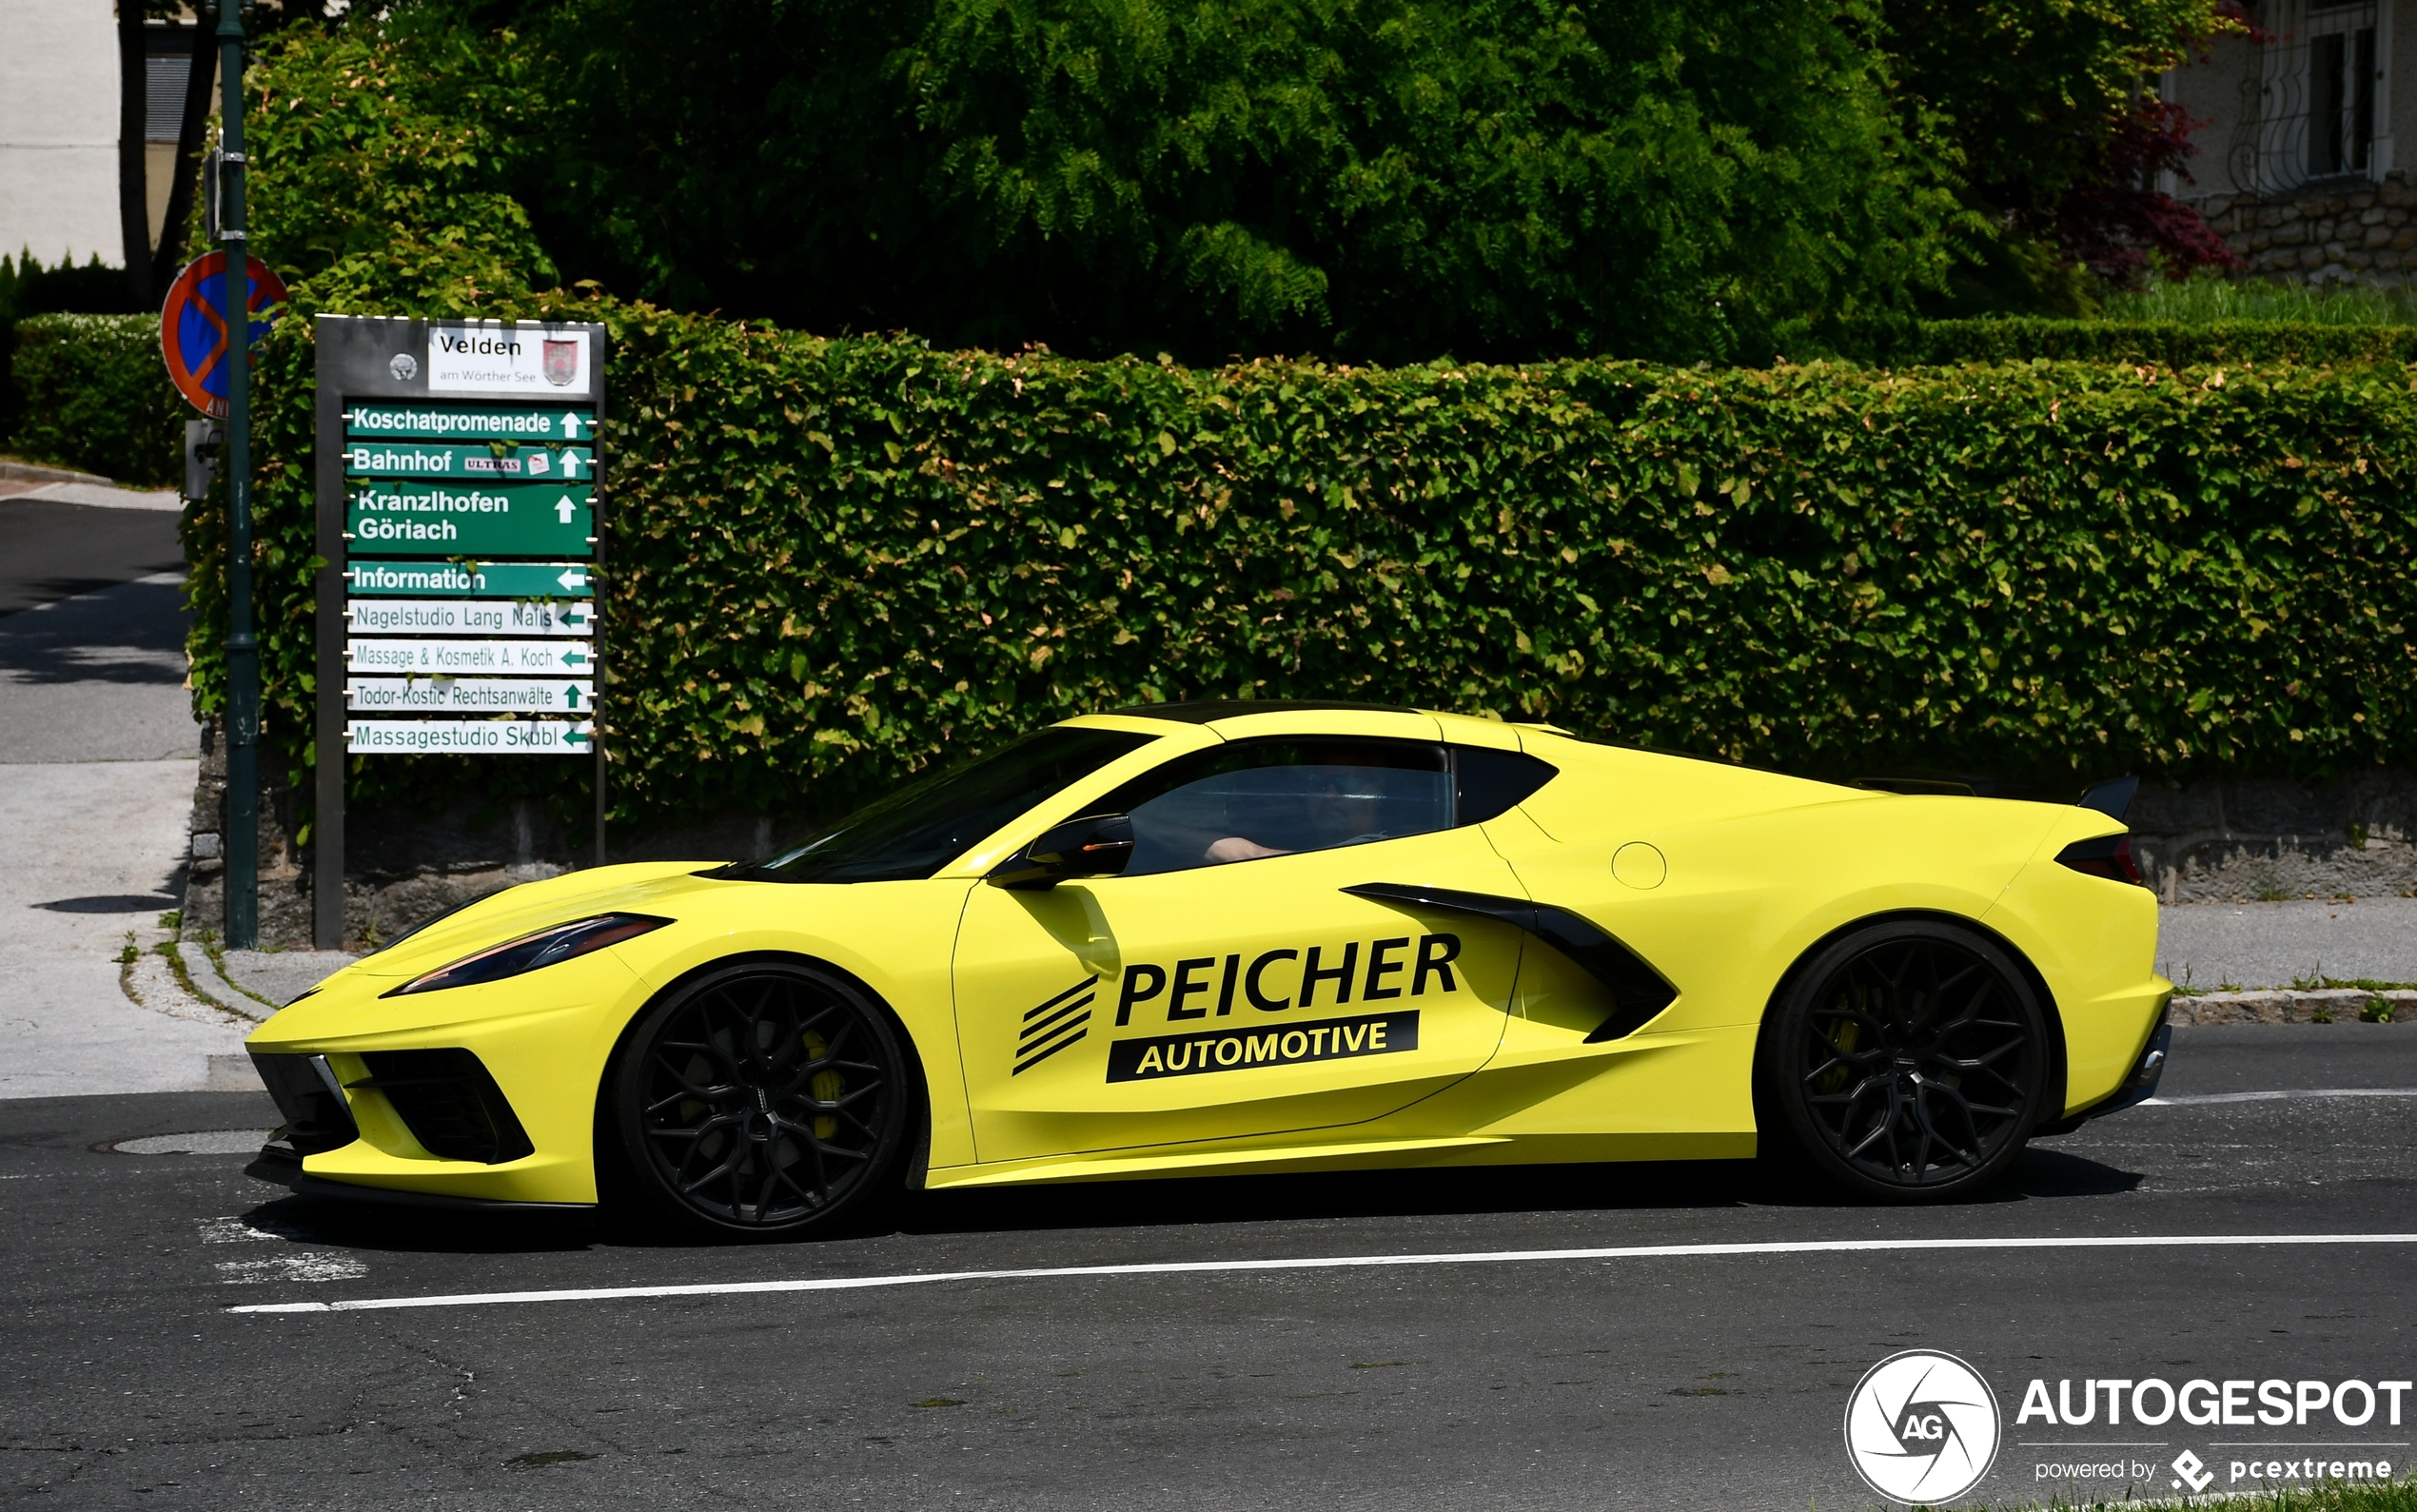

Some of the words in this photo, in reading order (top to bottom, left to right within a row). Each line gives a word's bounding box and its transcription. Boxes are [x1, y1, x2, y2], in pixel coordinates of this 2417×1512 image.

[441, 336, 521, 356] Velden
[462, 370, 512, 382] Wörther
[516, 373, 536, 382] See
[354, 408, 551, 433] Koschatpromenade
[354, 449, 452, 472] Bahnhof
[467, 460, 518, 470] ULTRAS
[359, 490, 509, 512] Kranzlhofen
[358, 519, 457, 540] Göriach
[354, 567, 486, 589] Information
[357, 607, 455, 628] Nagelstudio
[464, 608, 502, 629] Lang
[513, 608, 552, 627] Nails
[357, 645, 414, 668] Massage
[421, 648, 429, 665] &
[437, 647, 495, 667] Kosmetik
[502, 649, 514, 666] A.
[521, 648, 553, 666] Koch
[453, 686, 553, 705] Rechtsanwälte
[356, 726, 498, 748] Massagestudio
[506, 727, 558, 745] Skubl
[1115, 933, 1462, 1027] PEICHER
[1136, 1022, 1387, 1074] AUTOMOTIVE
